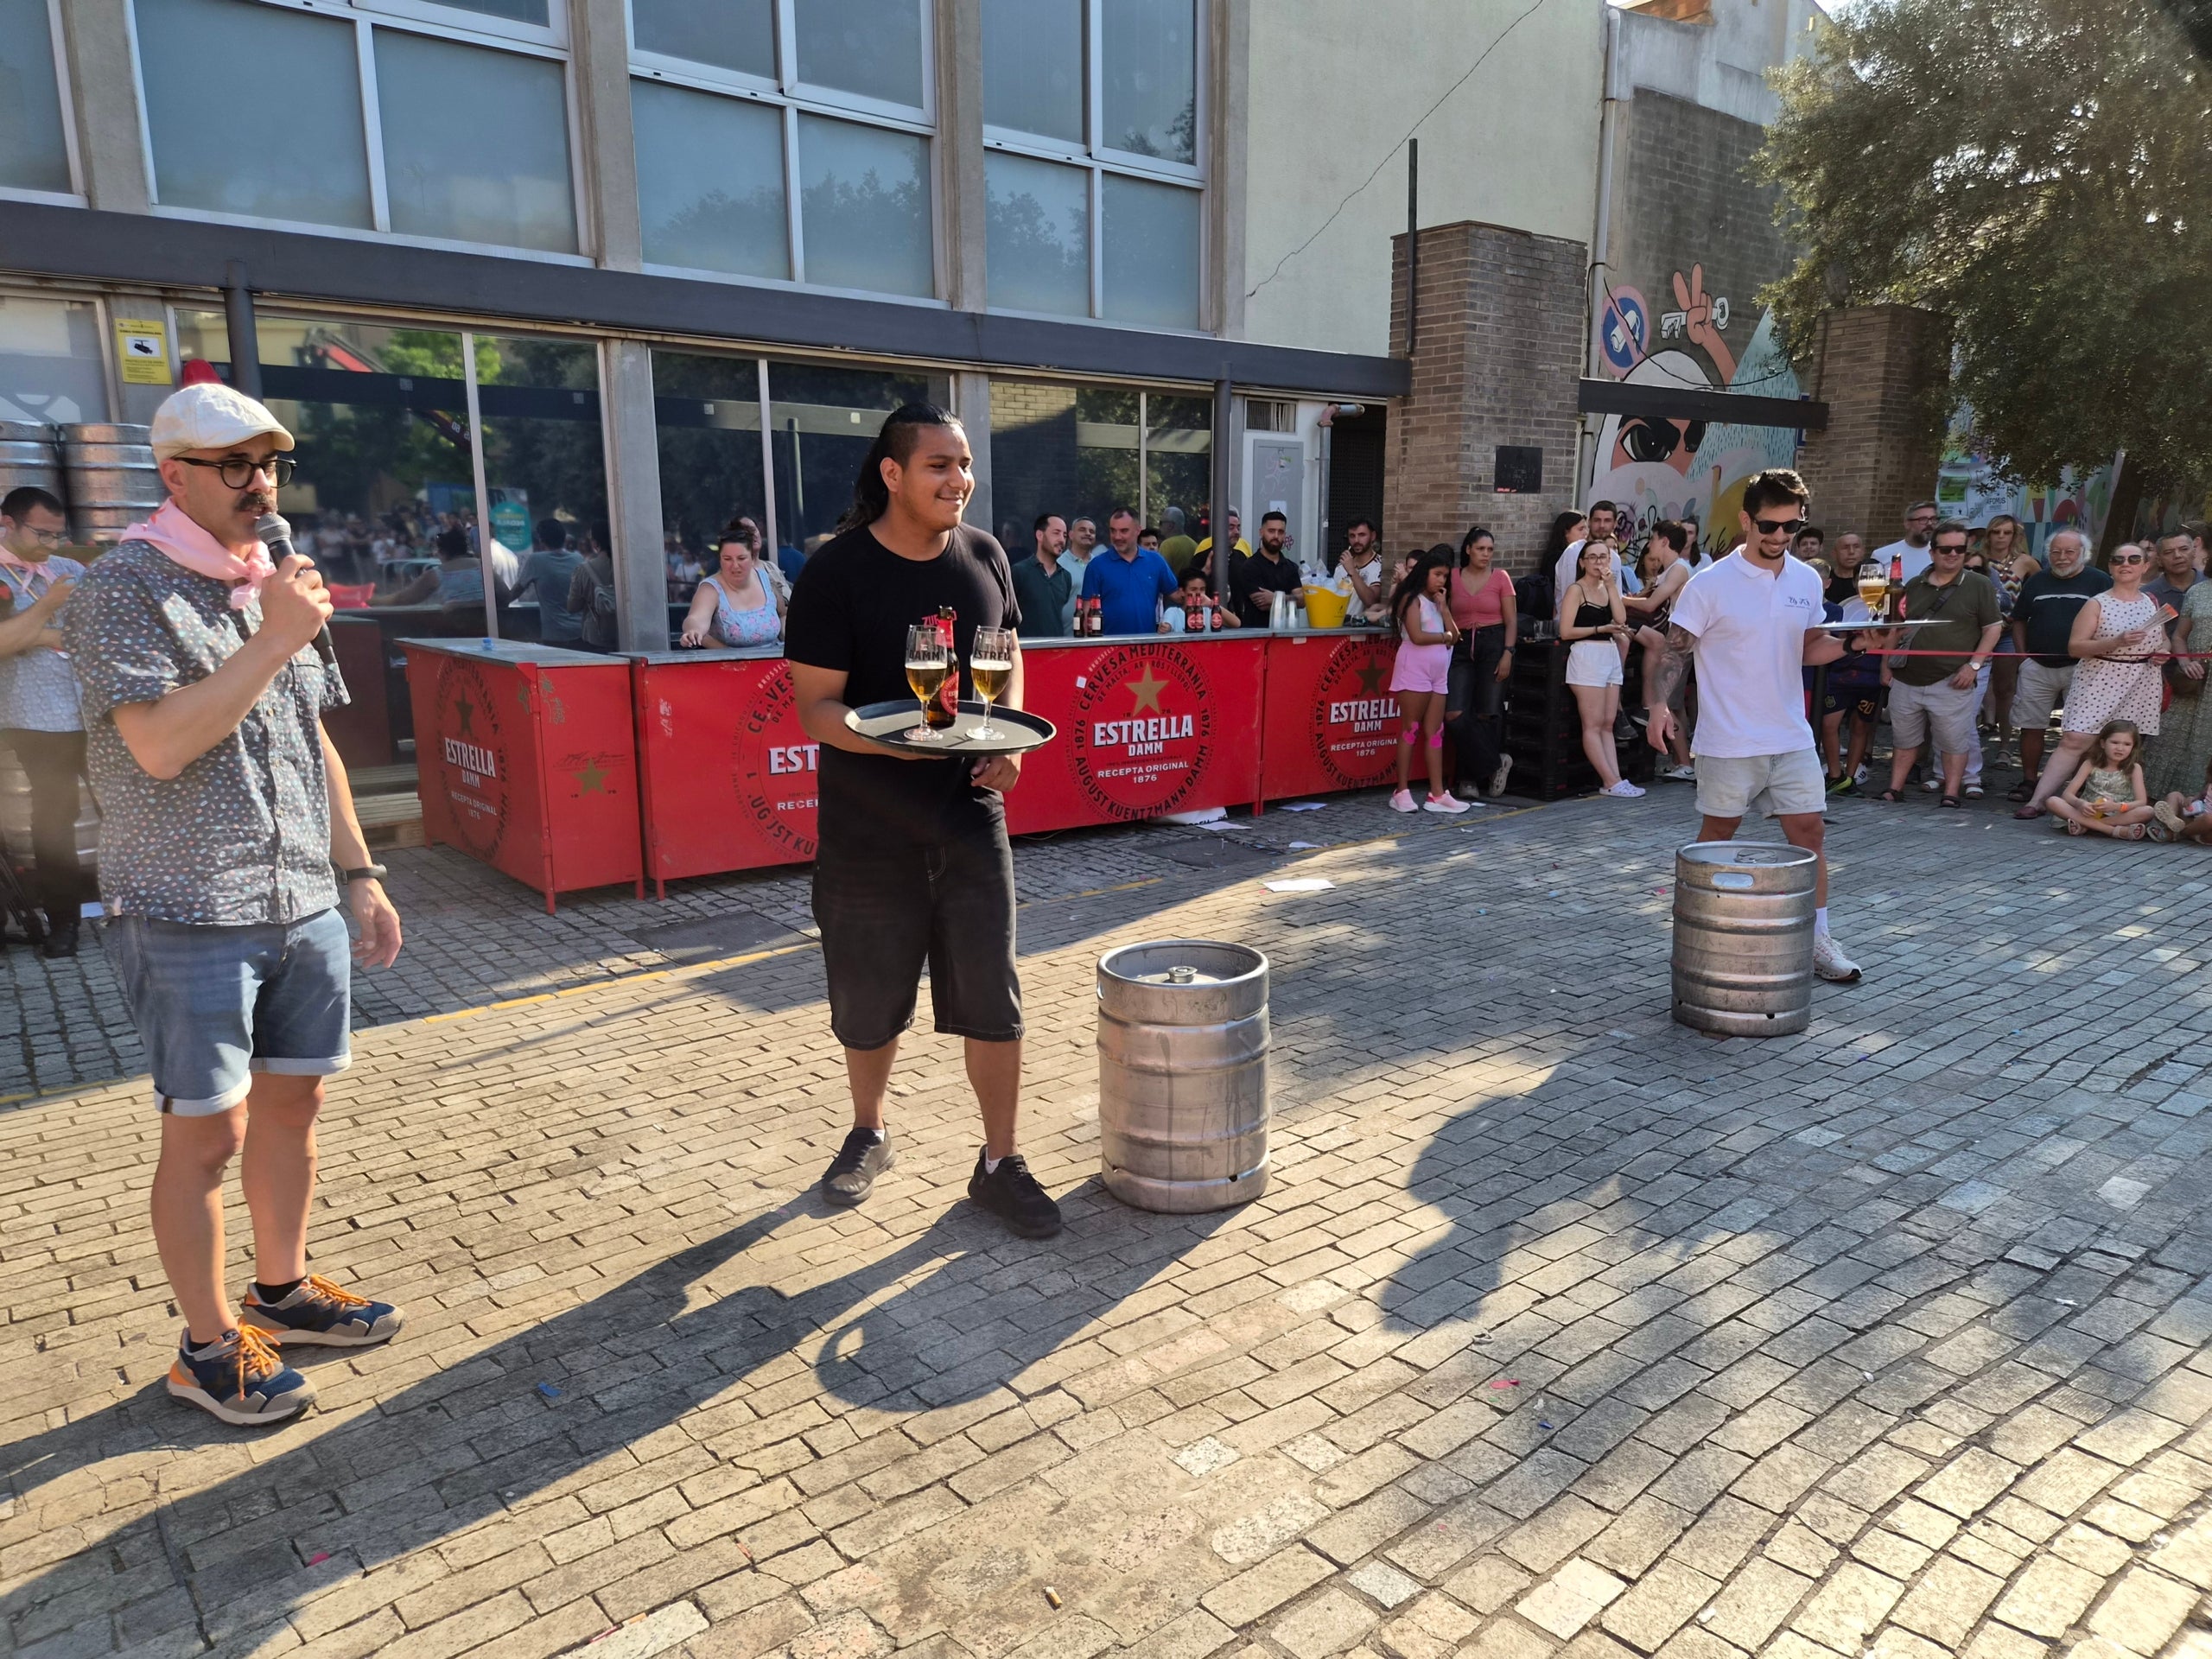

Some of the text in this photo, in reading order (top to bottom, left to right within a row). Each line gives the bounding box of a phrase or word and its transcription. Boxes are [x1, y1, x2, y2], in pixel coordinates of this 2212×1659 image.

[1079, 652, 1127, 710] CERVESA
[1315, 700, 1325, 726] 1876
[1320, 642, 1358, 692] CERVESA
[1097, 691, 1107, 702] DE
[772, 709, 784, 724] DE
[1858, 699, 1875, 715] 20
[1094, 715, 1194, 747] ESTRELLA
[1201, 708, 1210, 737] 1876
[1353, 720, 1382, 733] DAMM
[1075, 719, 1086, 750] 1876
[1128, 741, 1163, 757] DAMM
[1315, 733, 1338, 776] AUGUST
[1331, 741, 1366, 752] RECEPTA
[1356, 748, 1376, 757] 1876
[444, 737, 496, 778] ESTRELLA
[461, 769, 480, 789] DAMM
[1097, 761, 1189, 778] RECEPTA ORIGINAL
[1134, 774, 1158, 784] 1876
[1075, 757, 1109, 807] AUGUST
[1107, 785, 1187, 821] KUENTZMANN
[1185, 745, 1208, 787] DAMM
[451, 790, 498, 816] RECEPTA ORIGINAL
[467, 808, 481, 820] 1876
[792, 836, 816, 855] KU
